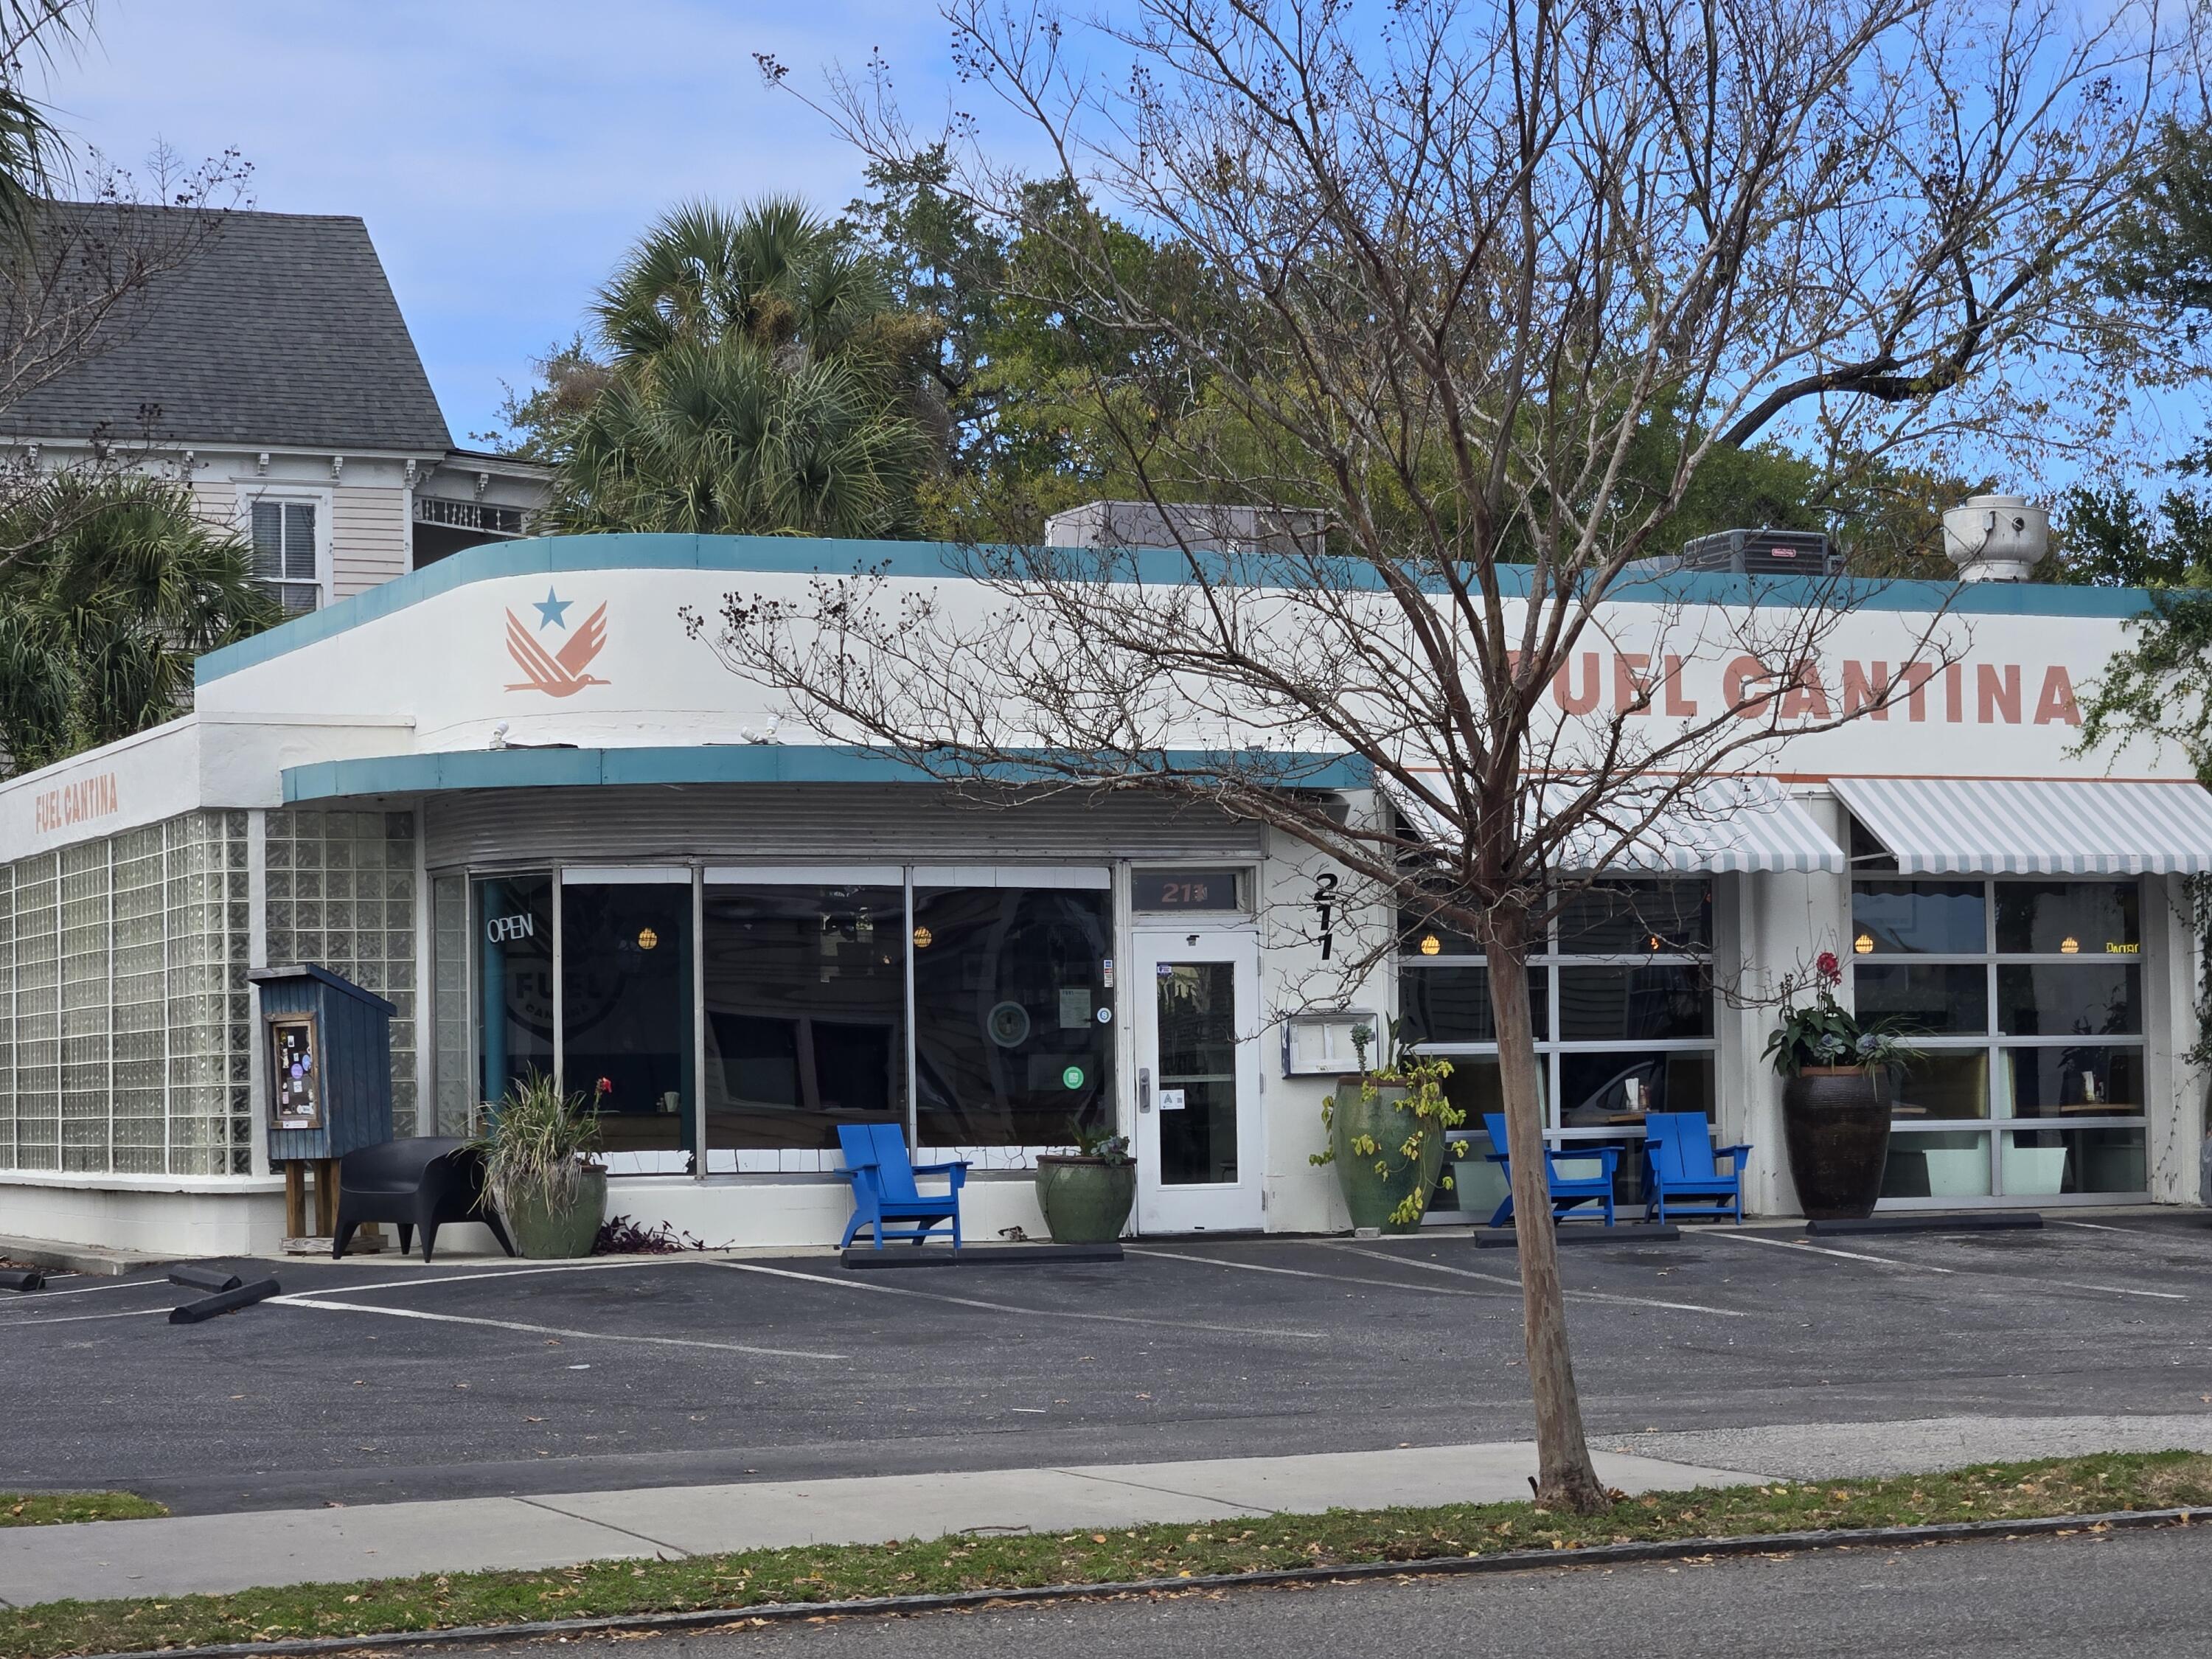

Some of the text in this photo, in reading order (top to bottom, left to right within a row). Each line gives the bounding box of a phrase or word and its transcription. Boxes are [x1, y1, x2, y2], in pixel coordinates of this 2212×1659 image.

[1506, 650, 2083, 725] UEL CANTINA
[36, 772, 118, 834] FUEL CANTINA
[1161, 883, 1204, 902] 211
[1314, 874, 1338, 960] 211
[487, 914, 533, 942] OPEN
